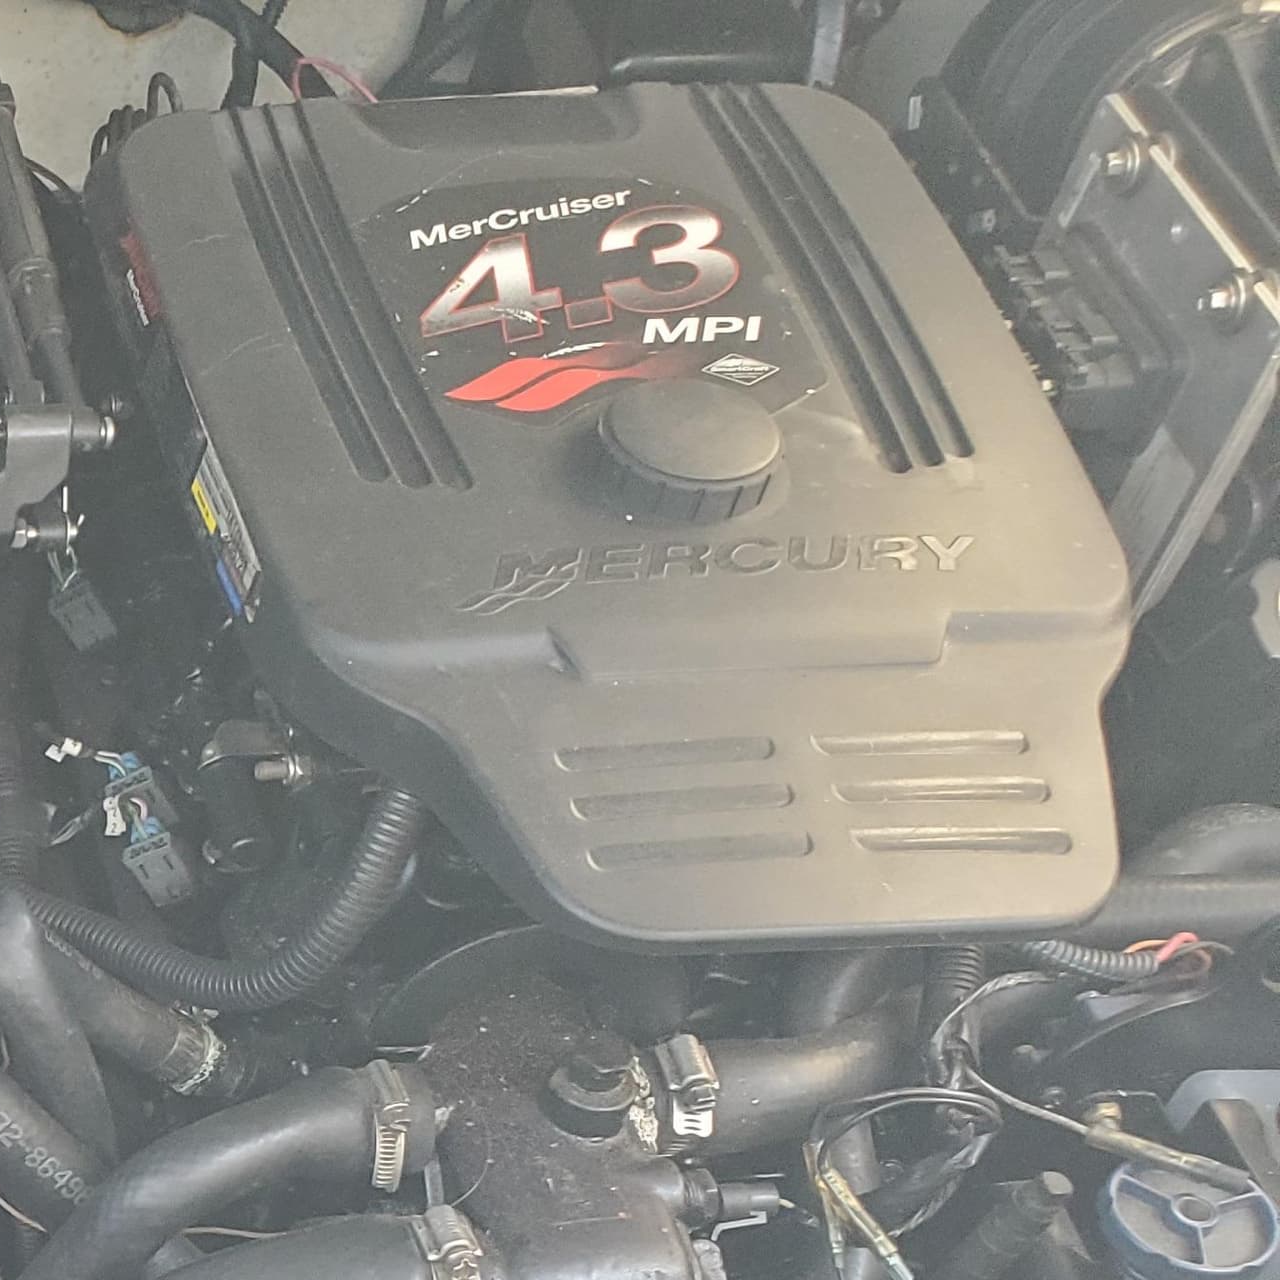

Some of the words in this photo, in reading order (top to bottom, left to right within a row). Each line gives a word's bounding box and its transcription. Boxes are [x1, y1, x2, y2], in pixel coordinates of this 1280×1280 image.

[409, 188, 631, 250] MerCruiser
[419, 204, 740, 344] 4.3
[642, 315, 761, 344] MPI
[485, 535, 975, 596] MERCURY
